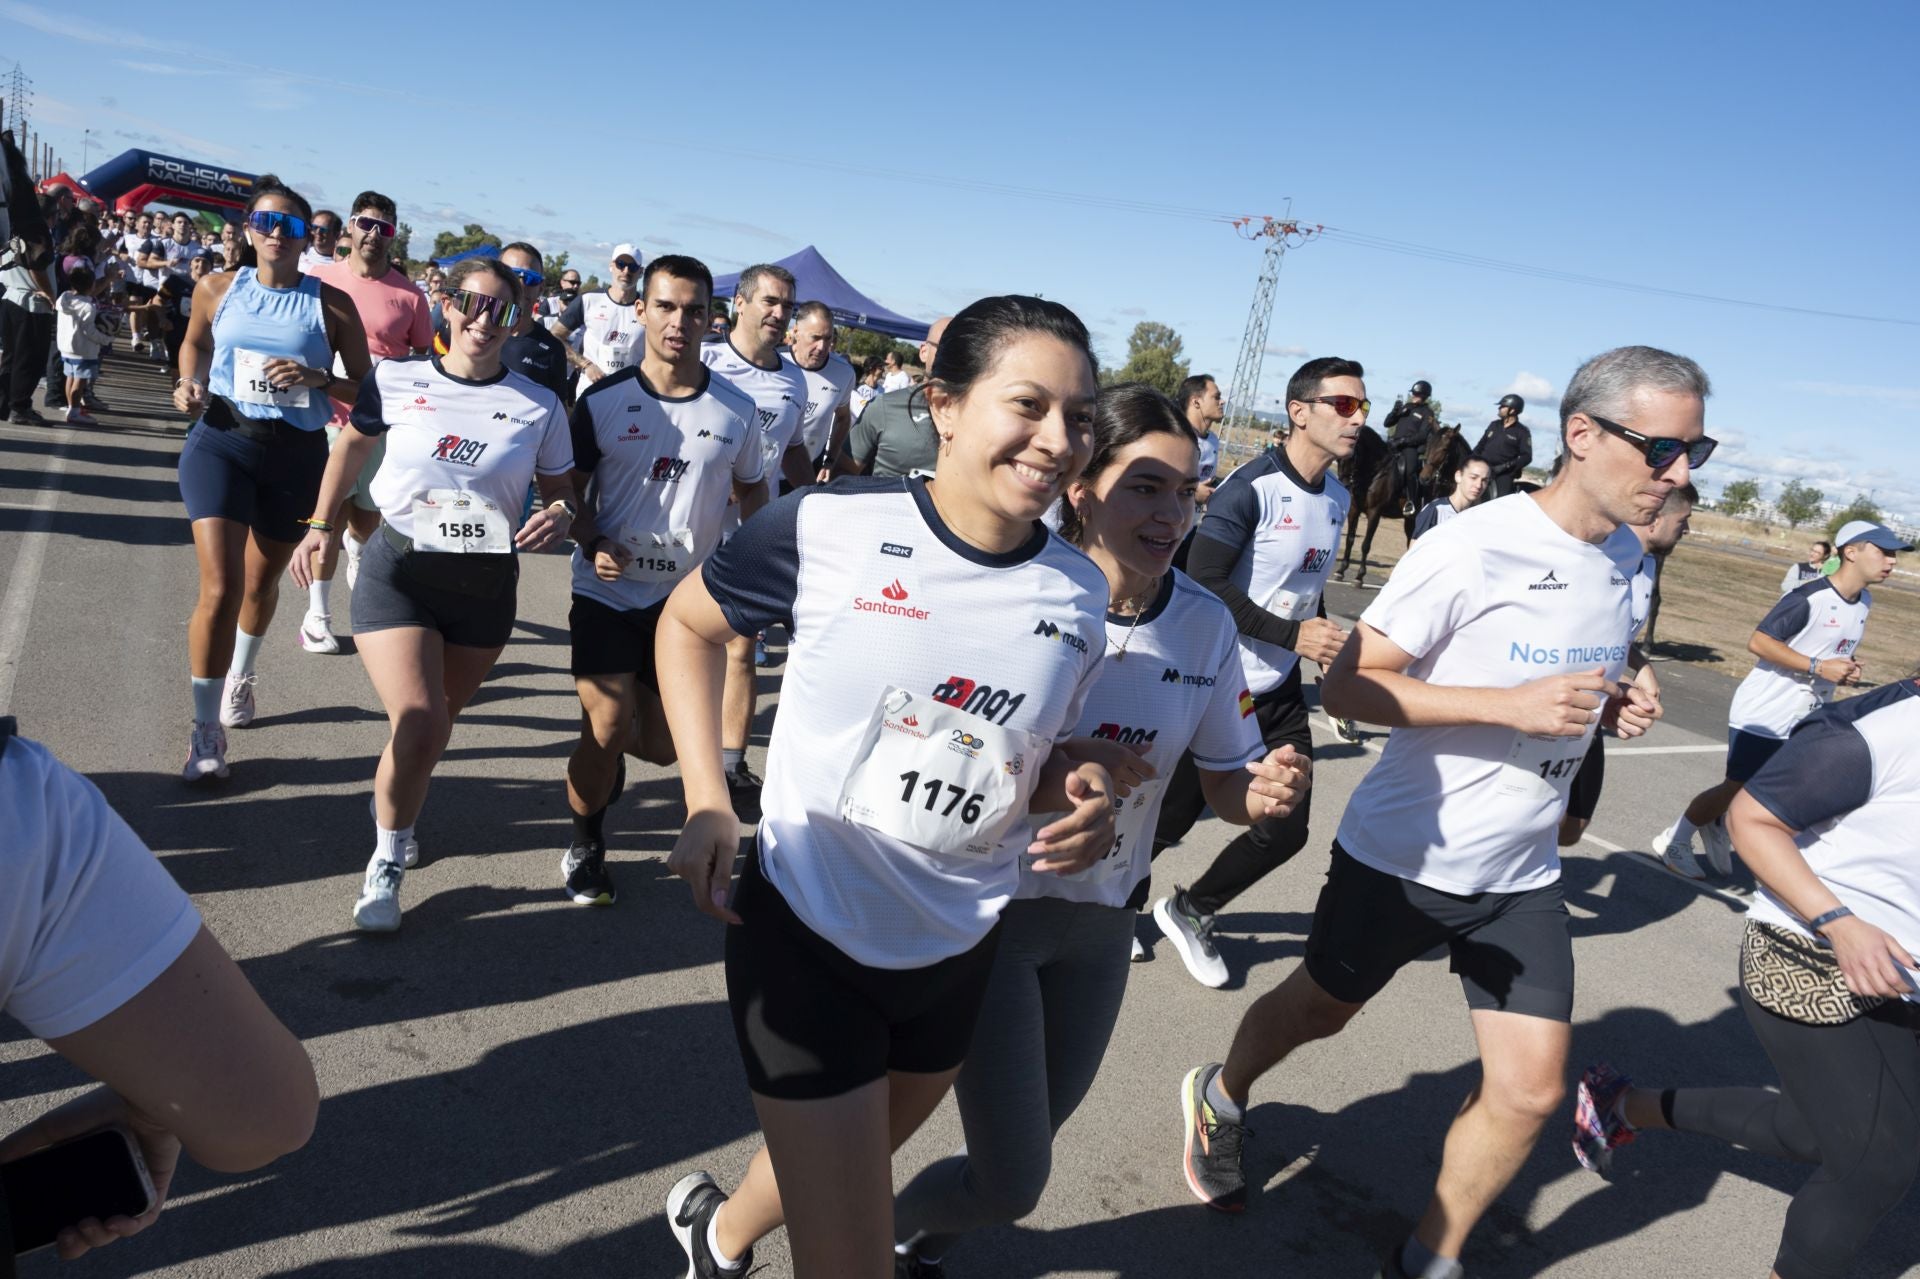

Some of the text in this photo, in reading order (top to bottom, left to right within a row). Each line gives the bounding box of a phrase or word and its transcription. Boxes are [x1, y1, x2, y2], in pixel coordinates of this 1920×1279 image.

[148, 157, 232, 184] POLICIA
[147, 167, 252, 198] NACIONAL
[402, 404, 437, 412] Santander
[510, 416, 535, 426] mupol
[617, 433, 650, 442] Santander
[713, 433, 734, 446] mupol
[438, 522, 486, 538] 1585
[635, 556, 677, 572] 1158
[1528, 582, 1570, 591] MERCURY
[853, 597, 931, 621] Santander
[1509, 641, 1627, 665] Nos mueves
[1182, 674, 1216, 688] mupol
[883, 717, 930, 742] Santander
[900, 770, 985, 825] 1176
